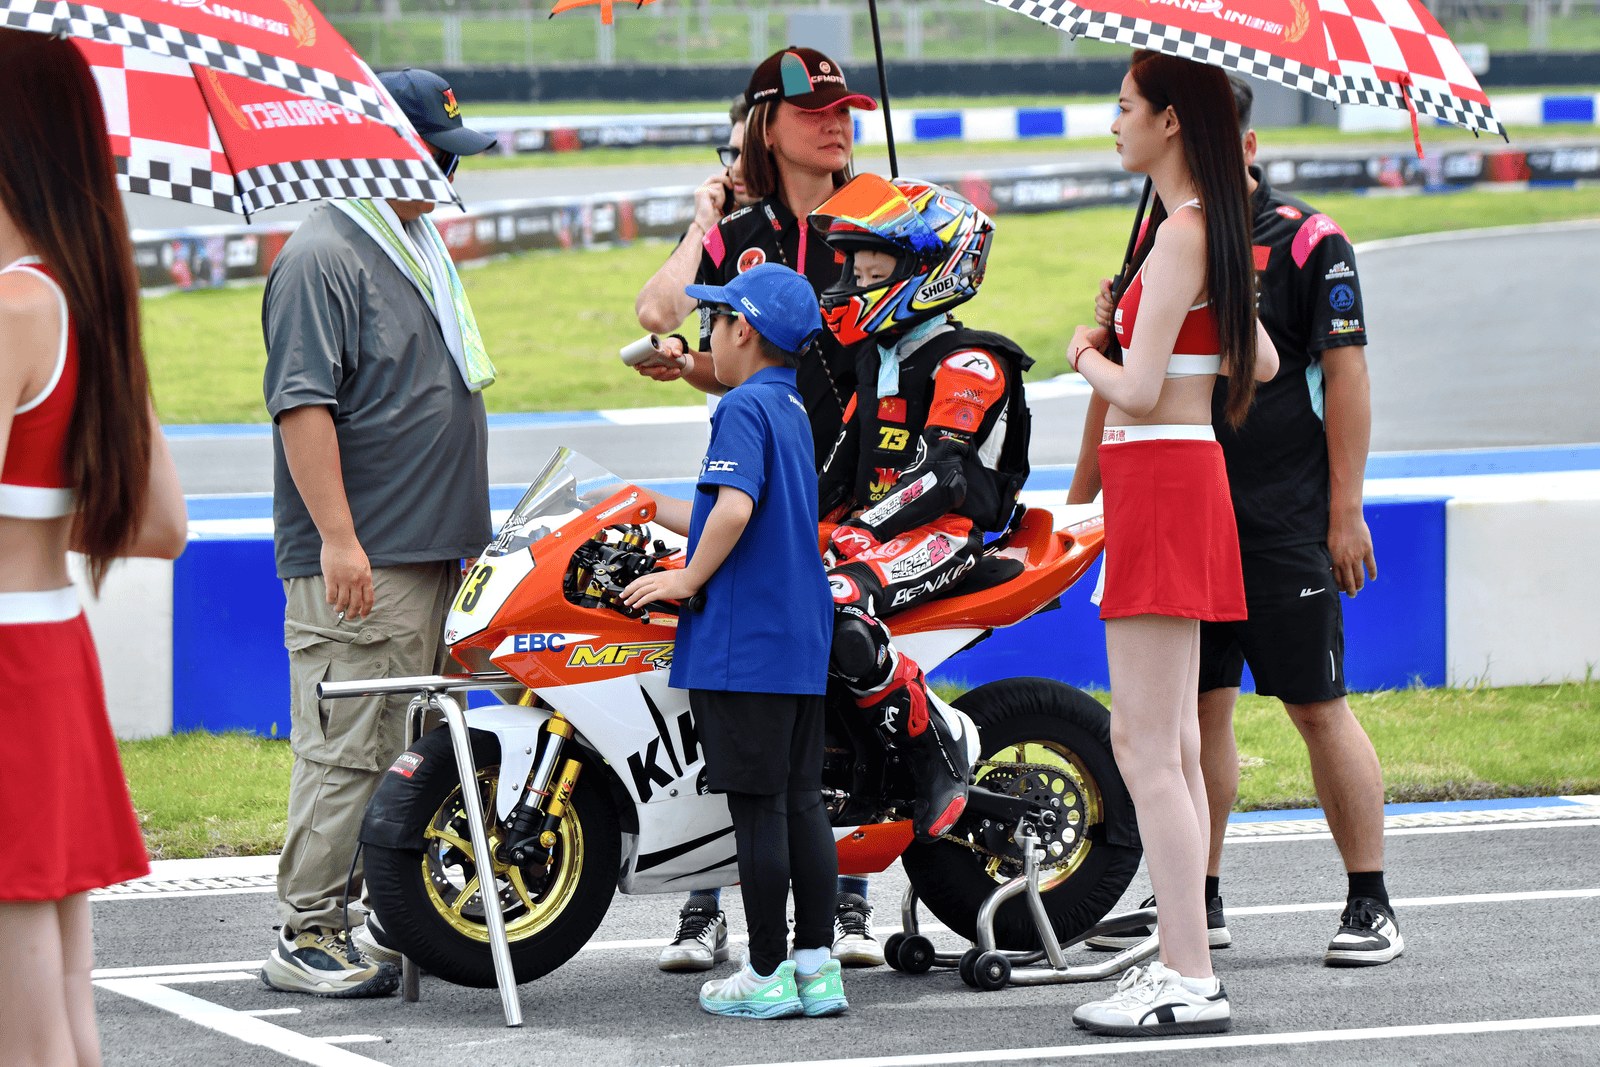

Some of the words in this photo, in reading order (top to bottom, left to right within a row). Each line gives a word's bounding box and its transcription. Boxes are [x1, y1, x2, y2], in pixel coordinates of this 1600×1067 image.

[921, 276, 954, 300] SHOEI
[878, 426, 910, 451] 73
[513, 633, 566, 653] EBC
